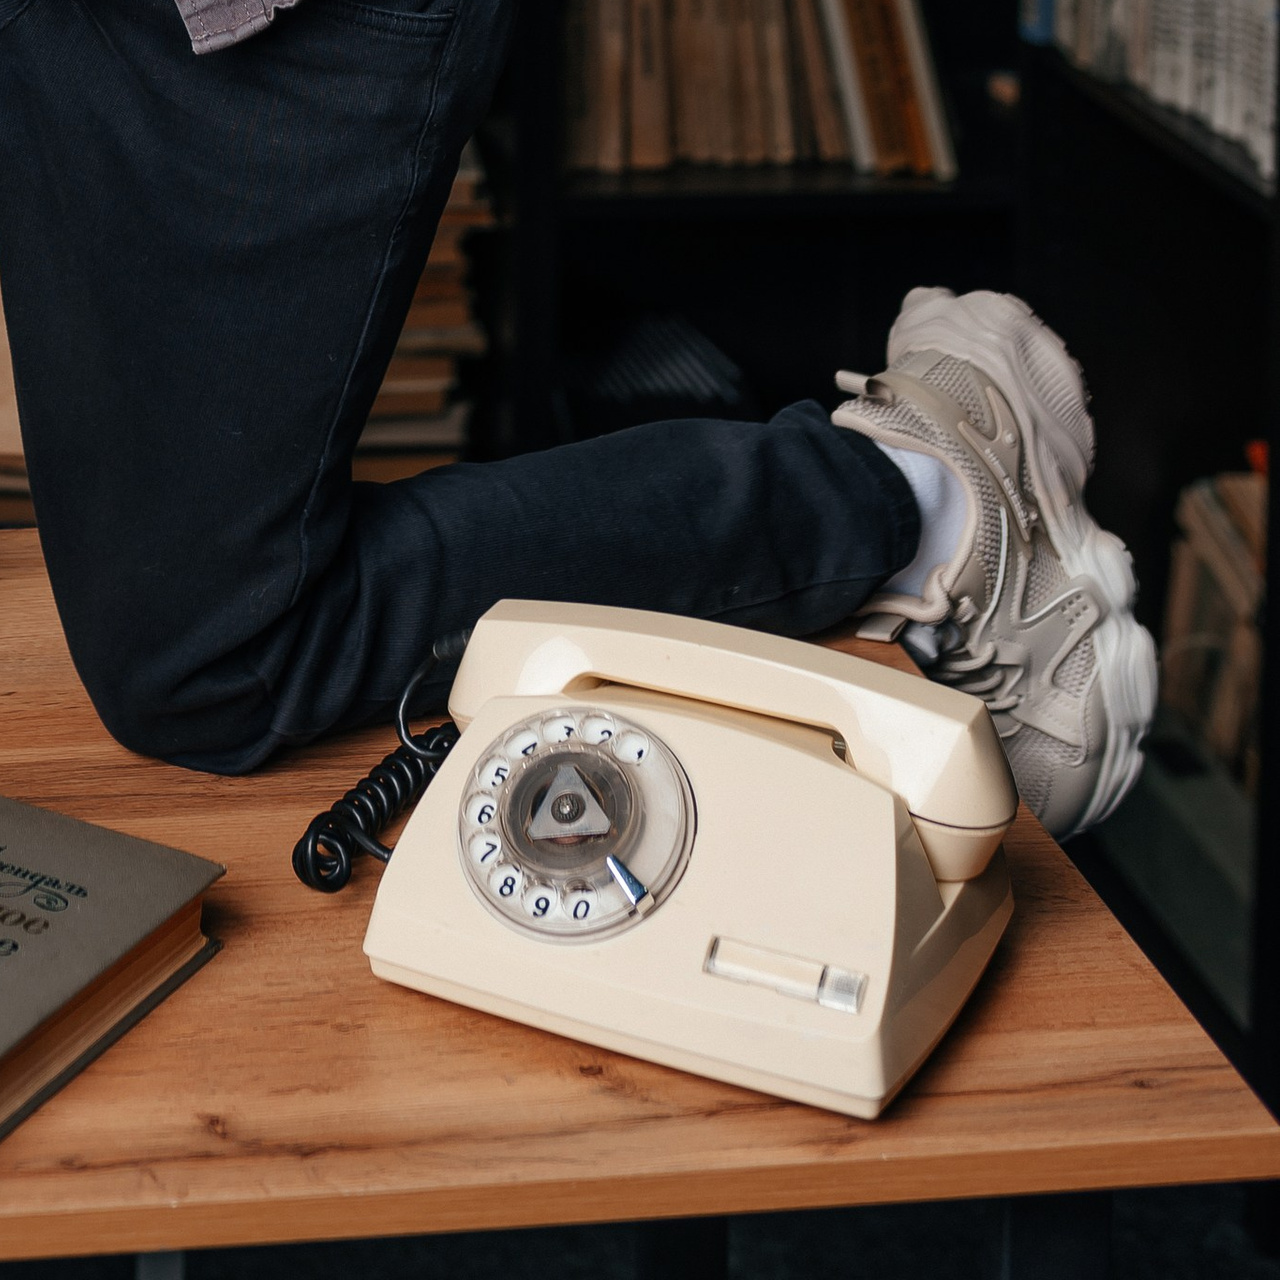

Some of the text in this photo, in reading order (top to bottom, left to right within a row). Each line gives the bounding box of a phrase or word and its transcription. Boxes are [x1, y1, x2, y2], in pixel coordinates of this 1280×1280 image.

[491, 766, 509, 788] 5
[477, 803, 495, 825] 6
[480, 841, 498, 864] 7
[498, 875, 517, 898] 8
[531, 895, 551, 918] 9
[572, 899, 591, 921] 0
